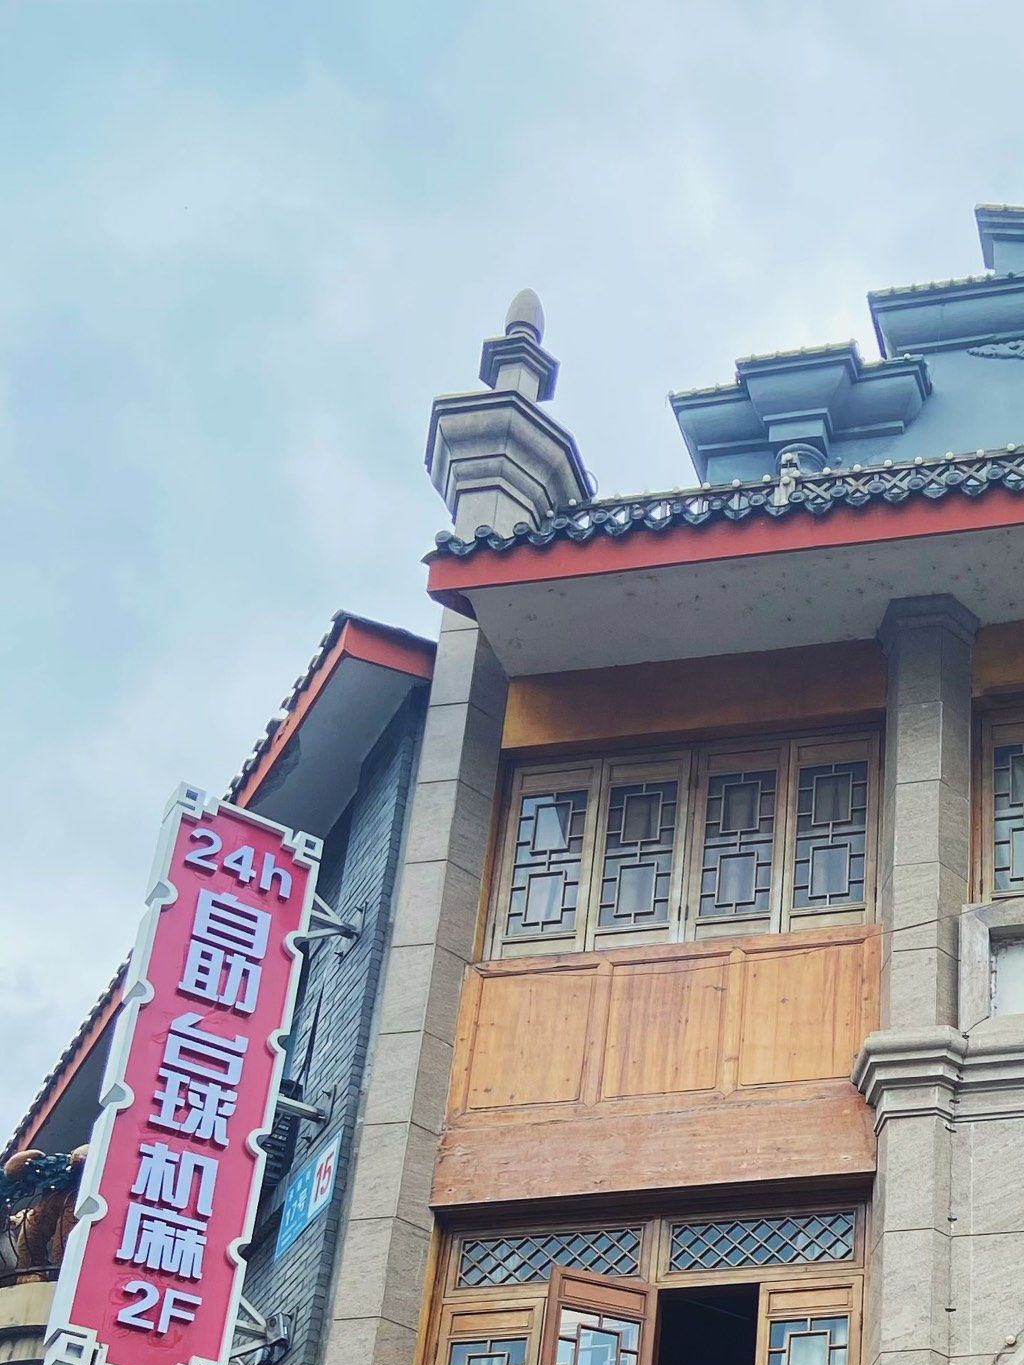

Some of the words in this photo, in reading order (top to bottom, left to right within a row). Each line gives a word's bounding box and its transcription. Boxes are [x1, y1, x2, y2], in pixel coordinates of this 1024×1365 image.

[185, 828, 293, 899] 24h
[116, 888, 272, 1280] 自助台球机麻
[314, 1151, 335, 1203] 15
[117, 1280, 203, 1334] 2F
